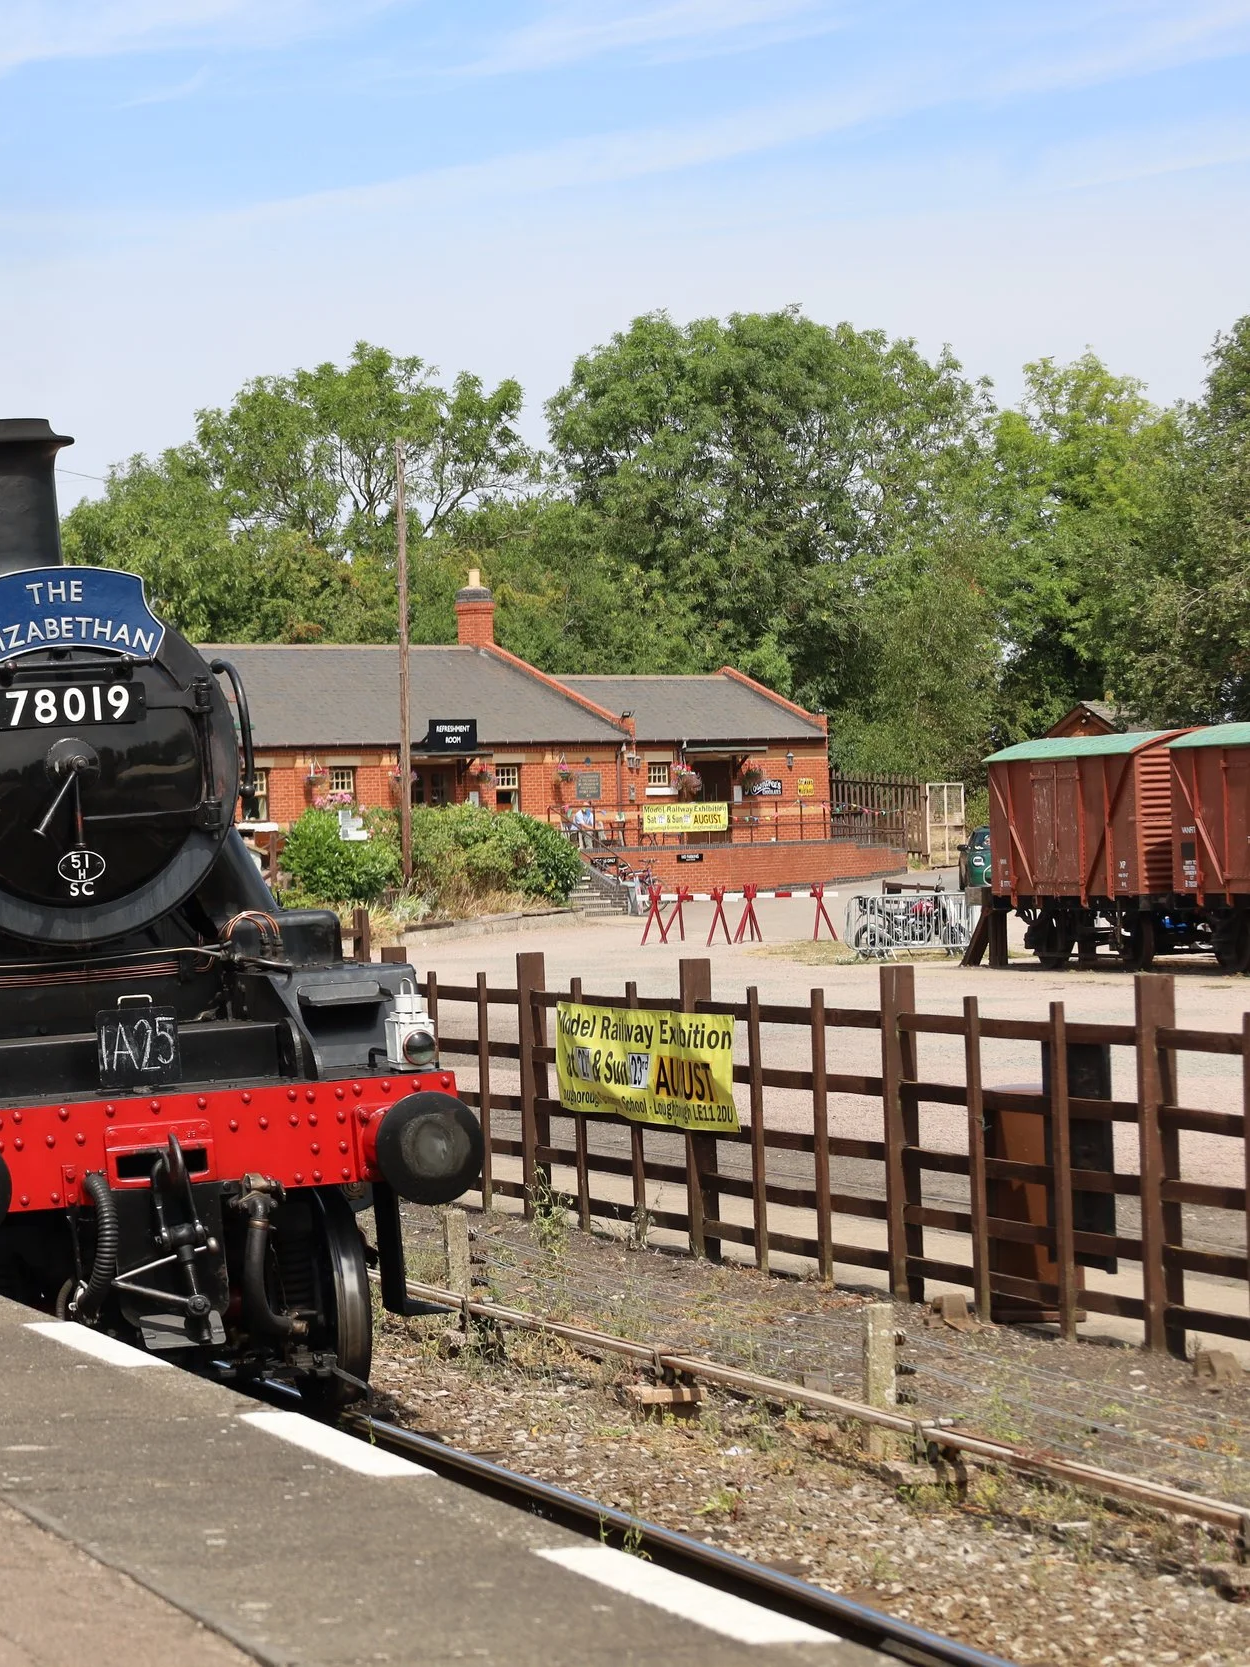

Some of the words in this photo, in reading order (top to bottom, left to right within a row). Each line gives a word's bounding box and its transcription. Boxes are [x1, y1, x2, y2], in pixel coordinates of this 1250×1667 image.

[26, 581, 83, 604] THE
[6, 685, 129, 726] 78019
[693, 814, 721, 824] AUGUST
[71, 854, 89, 869] 51
[78, 869, 86, 879] H
[70, 882, 94, 896] SC
[600, 1016, 654, 1049] Railway
[593, 1050, 602, 1082] &
[604, 1051, 629, 1085] Sun
